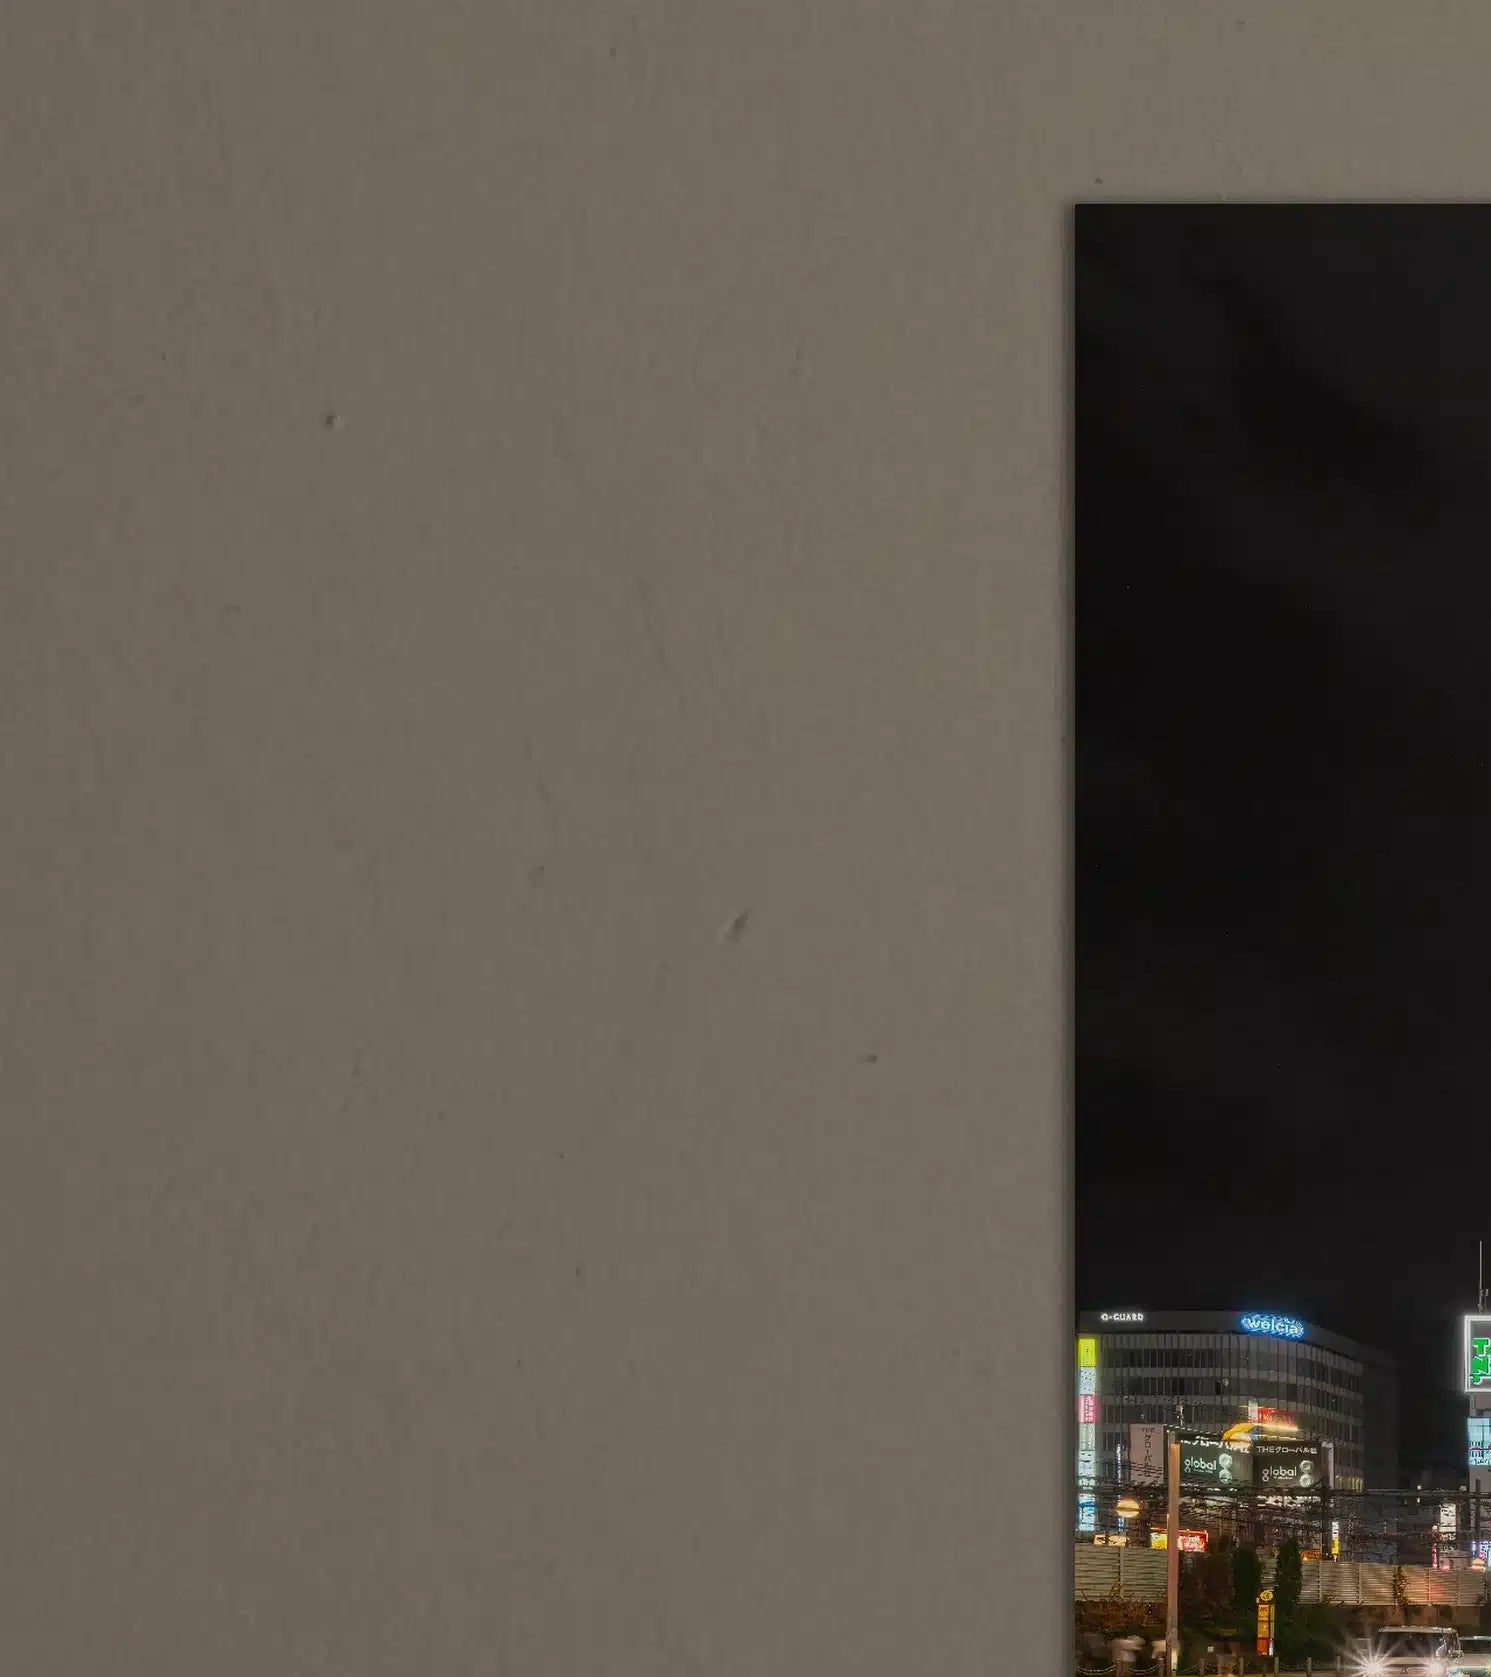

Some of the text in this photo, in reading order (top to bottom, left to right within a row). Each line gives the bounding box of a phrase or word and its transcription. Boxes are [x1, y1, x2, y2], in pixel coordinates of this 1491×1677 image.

[1247, 1317, 1301, 1335] welcia
[1184, 1456, 1217, 1473] global
[1261, 1466, 1297, 1482] global
